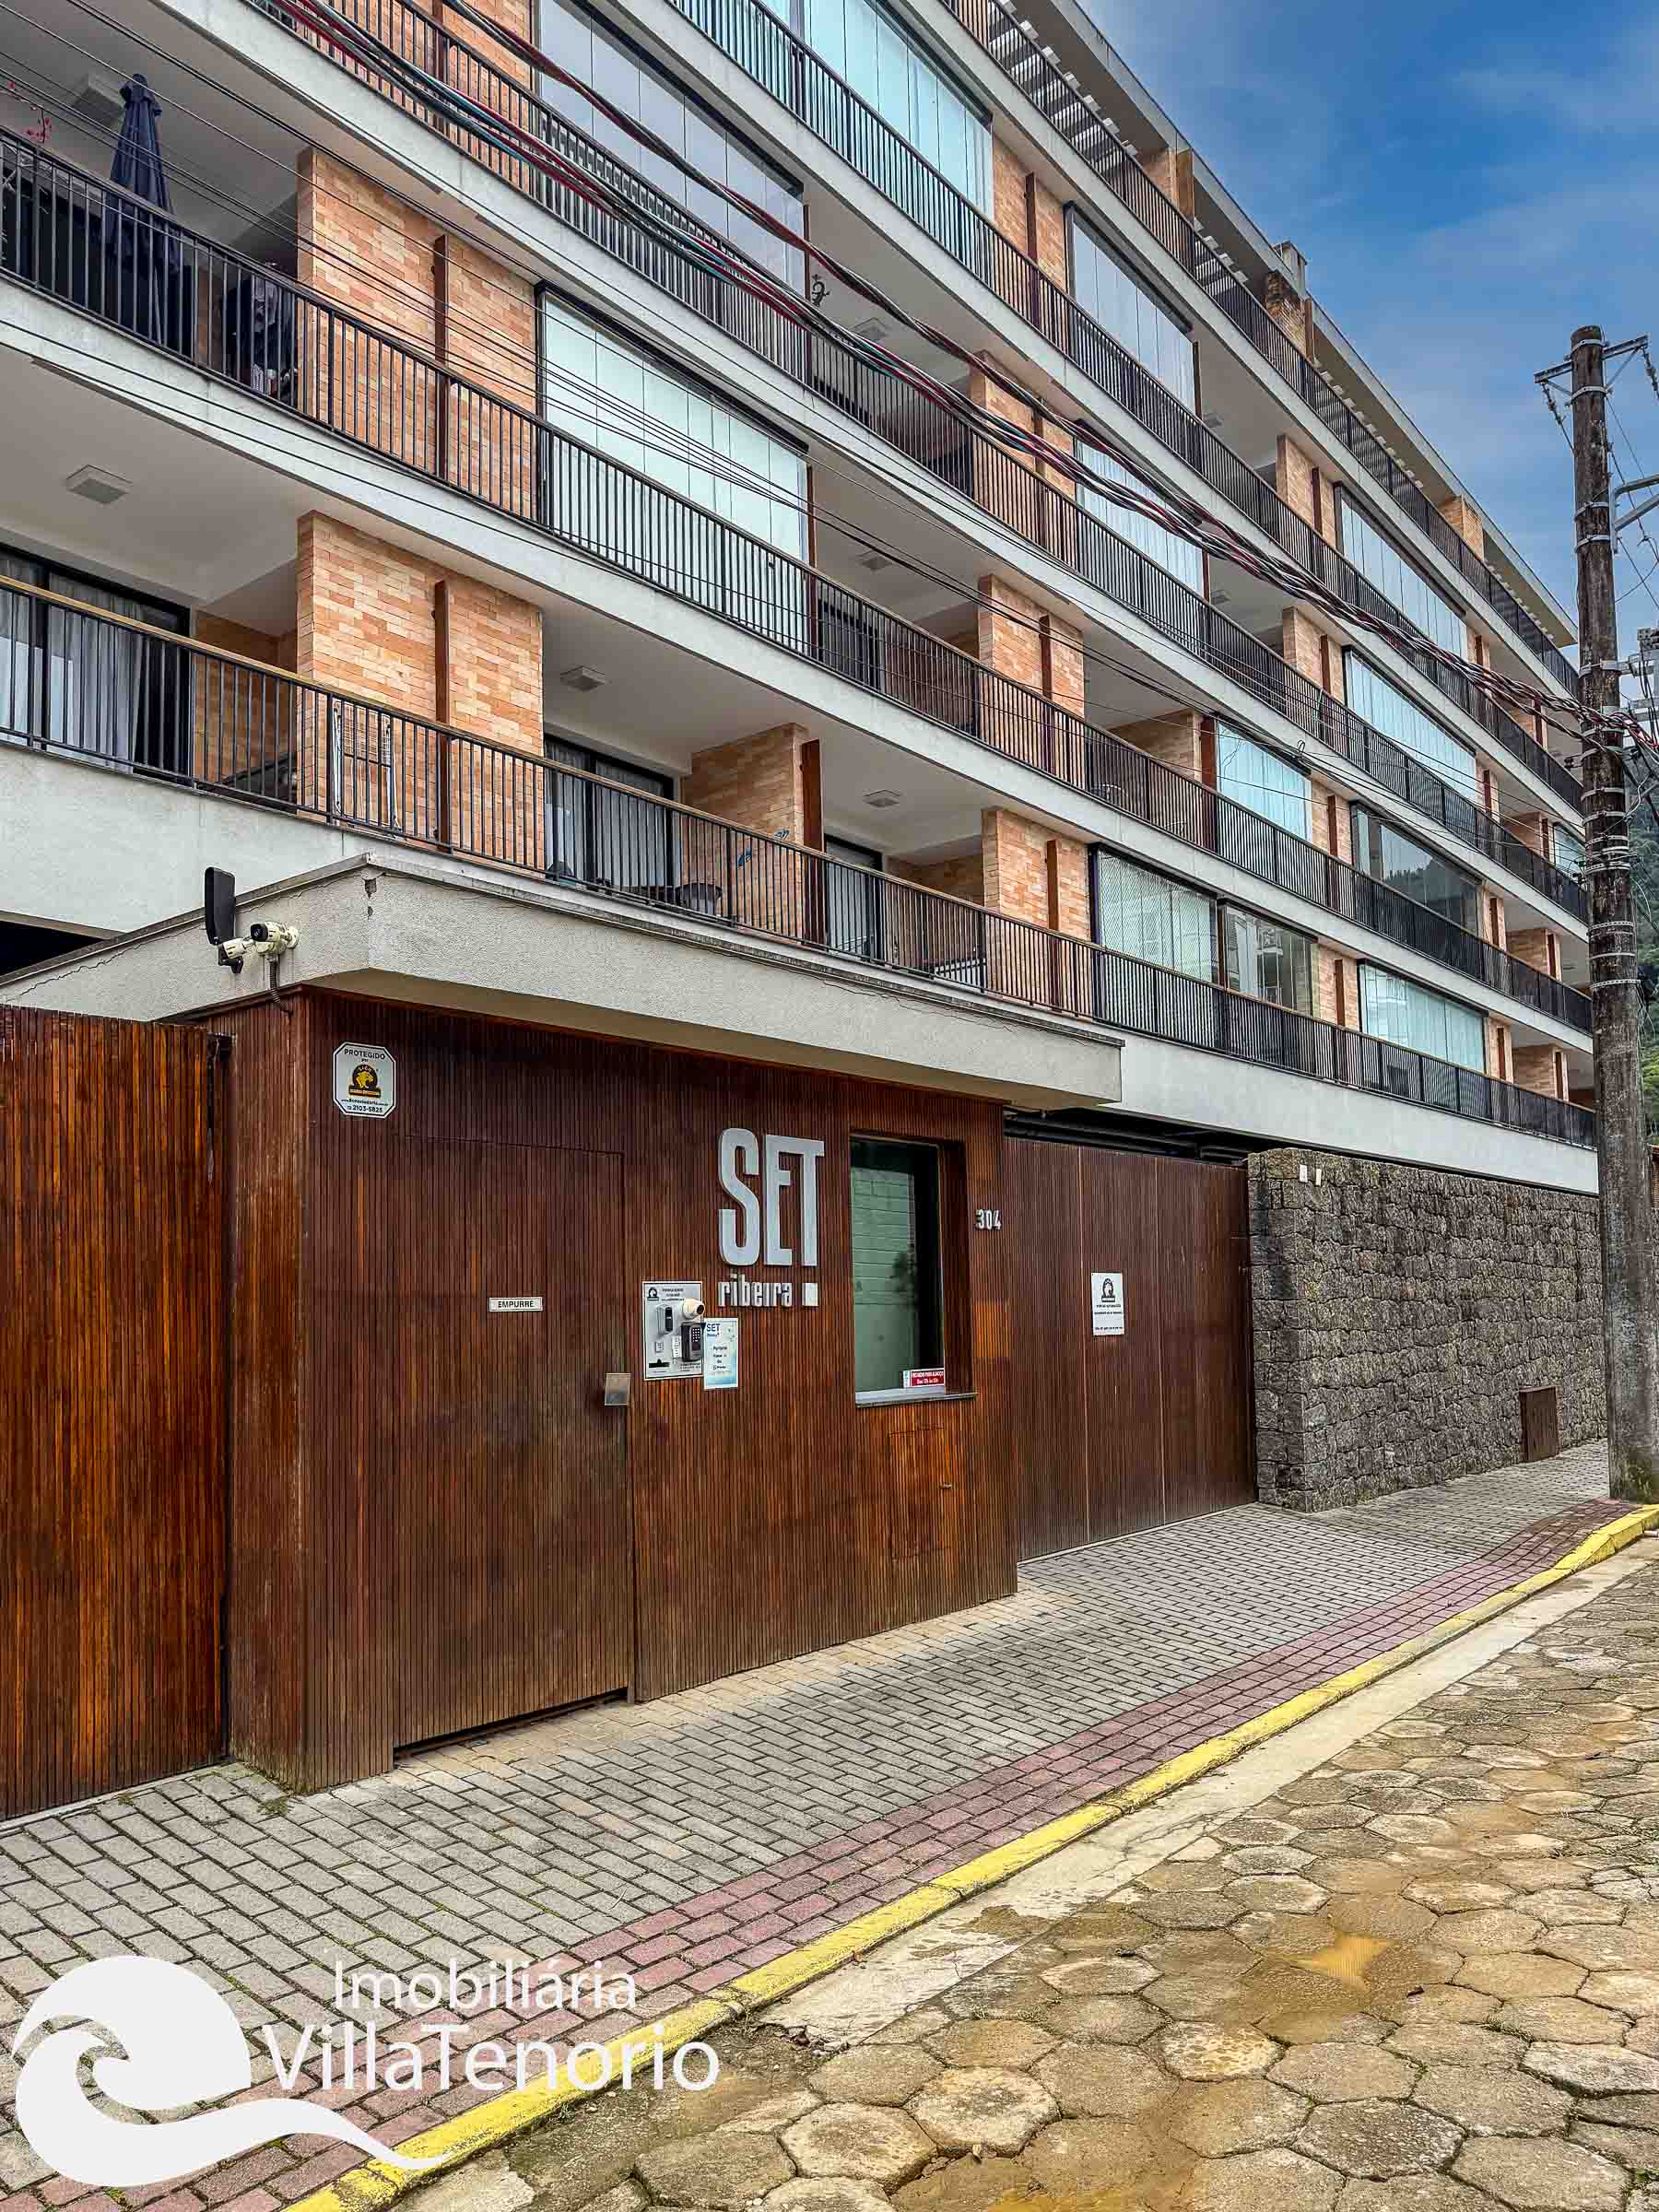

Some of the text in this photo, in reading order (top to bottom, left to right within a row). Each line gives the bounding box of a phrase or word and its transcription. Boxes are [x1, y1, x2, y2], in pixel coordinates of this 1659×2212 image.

[344, 1049, 385, 1059] PROTEGIDO
[718, 1127, 825, 1267] SET
[975, 1209, 1002, 1230] 304
[717, 1268, 793, 1308] ribeira
